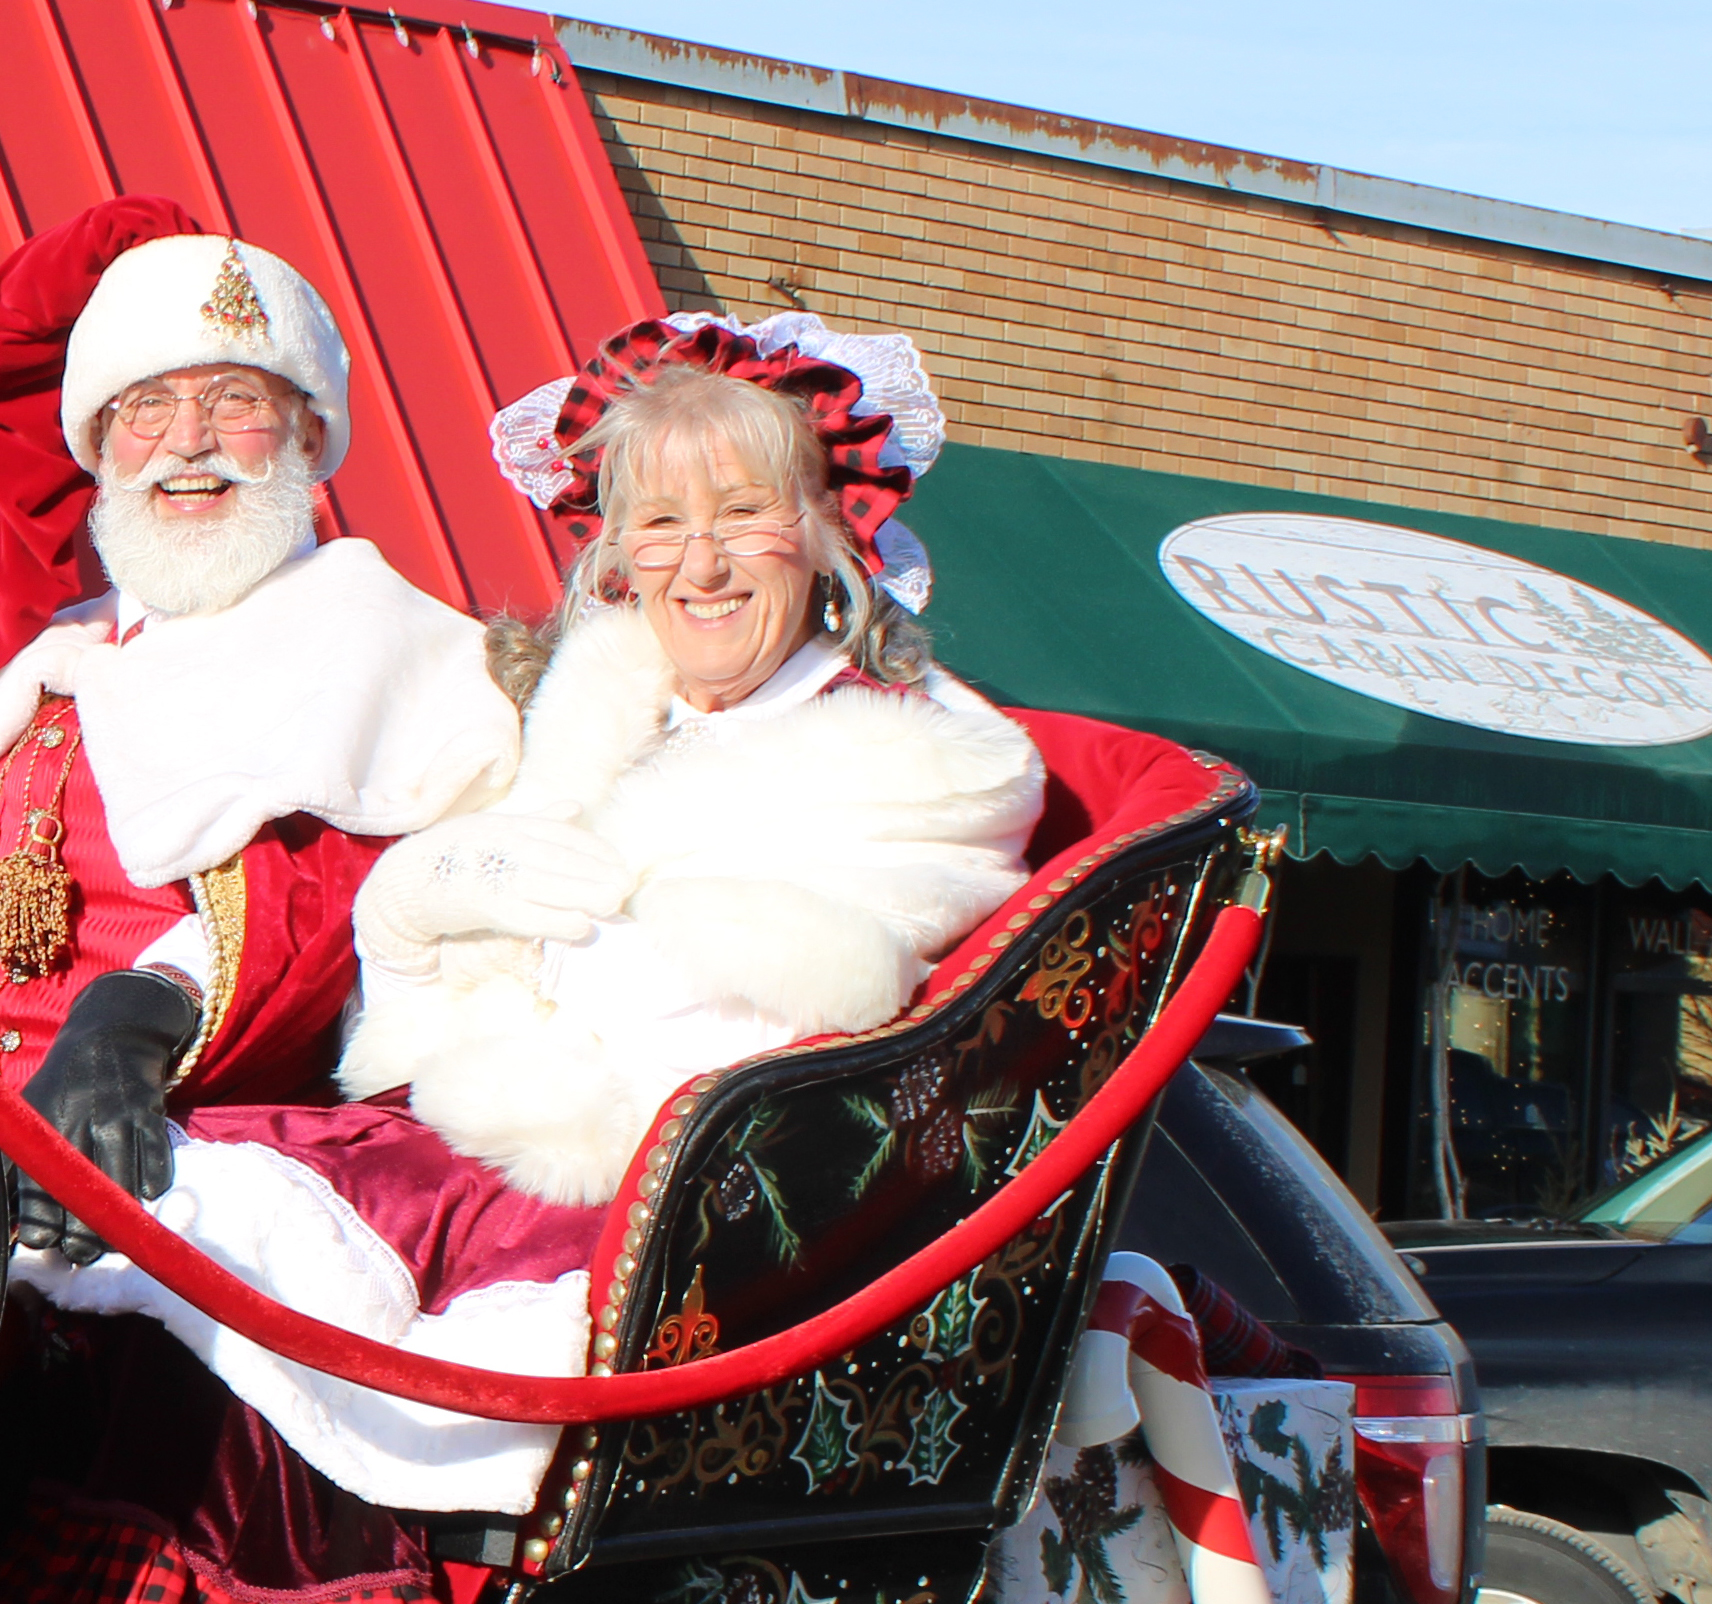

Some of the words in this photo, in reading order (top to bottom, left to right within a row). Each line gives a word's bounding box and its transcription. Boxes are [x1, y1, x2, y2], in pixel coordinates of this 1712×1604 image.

[1171, 552, 1561, 655] RUSTIC
[1263, 626, 1480, 688] CABIN
[1486, 654, 1712, 713] DECOR
[1469, 905, 1554, 946] HOME
[1628, 916, 1698, 956] WALL
[1445, 961, 1571, 1002] ACCENTS
